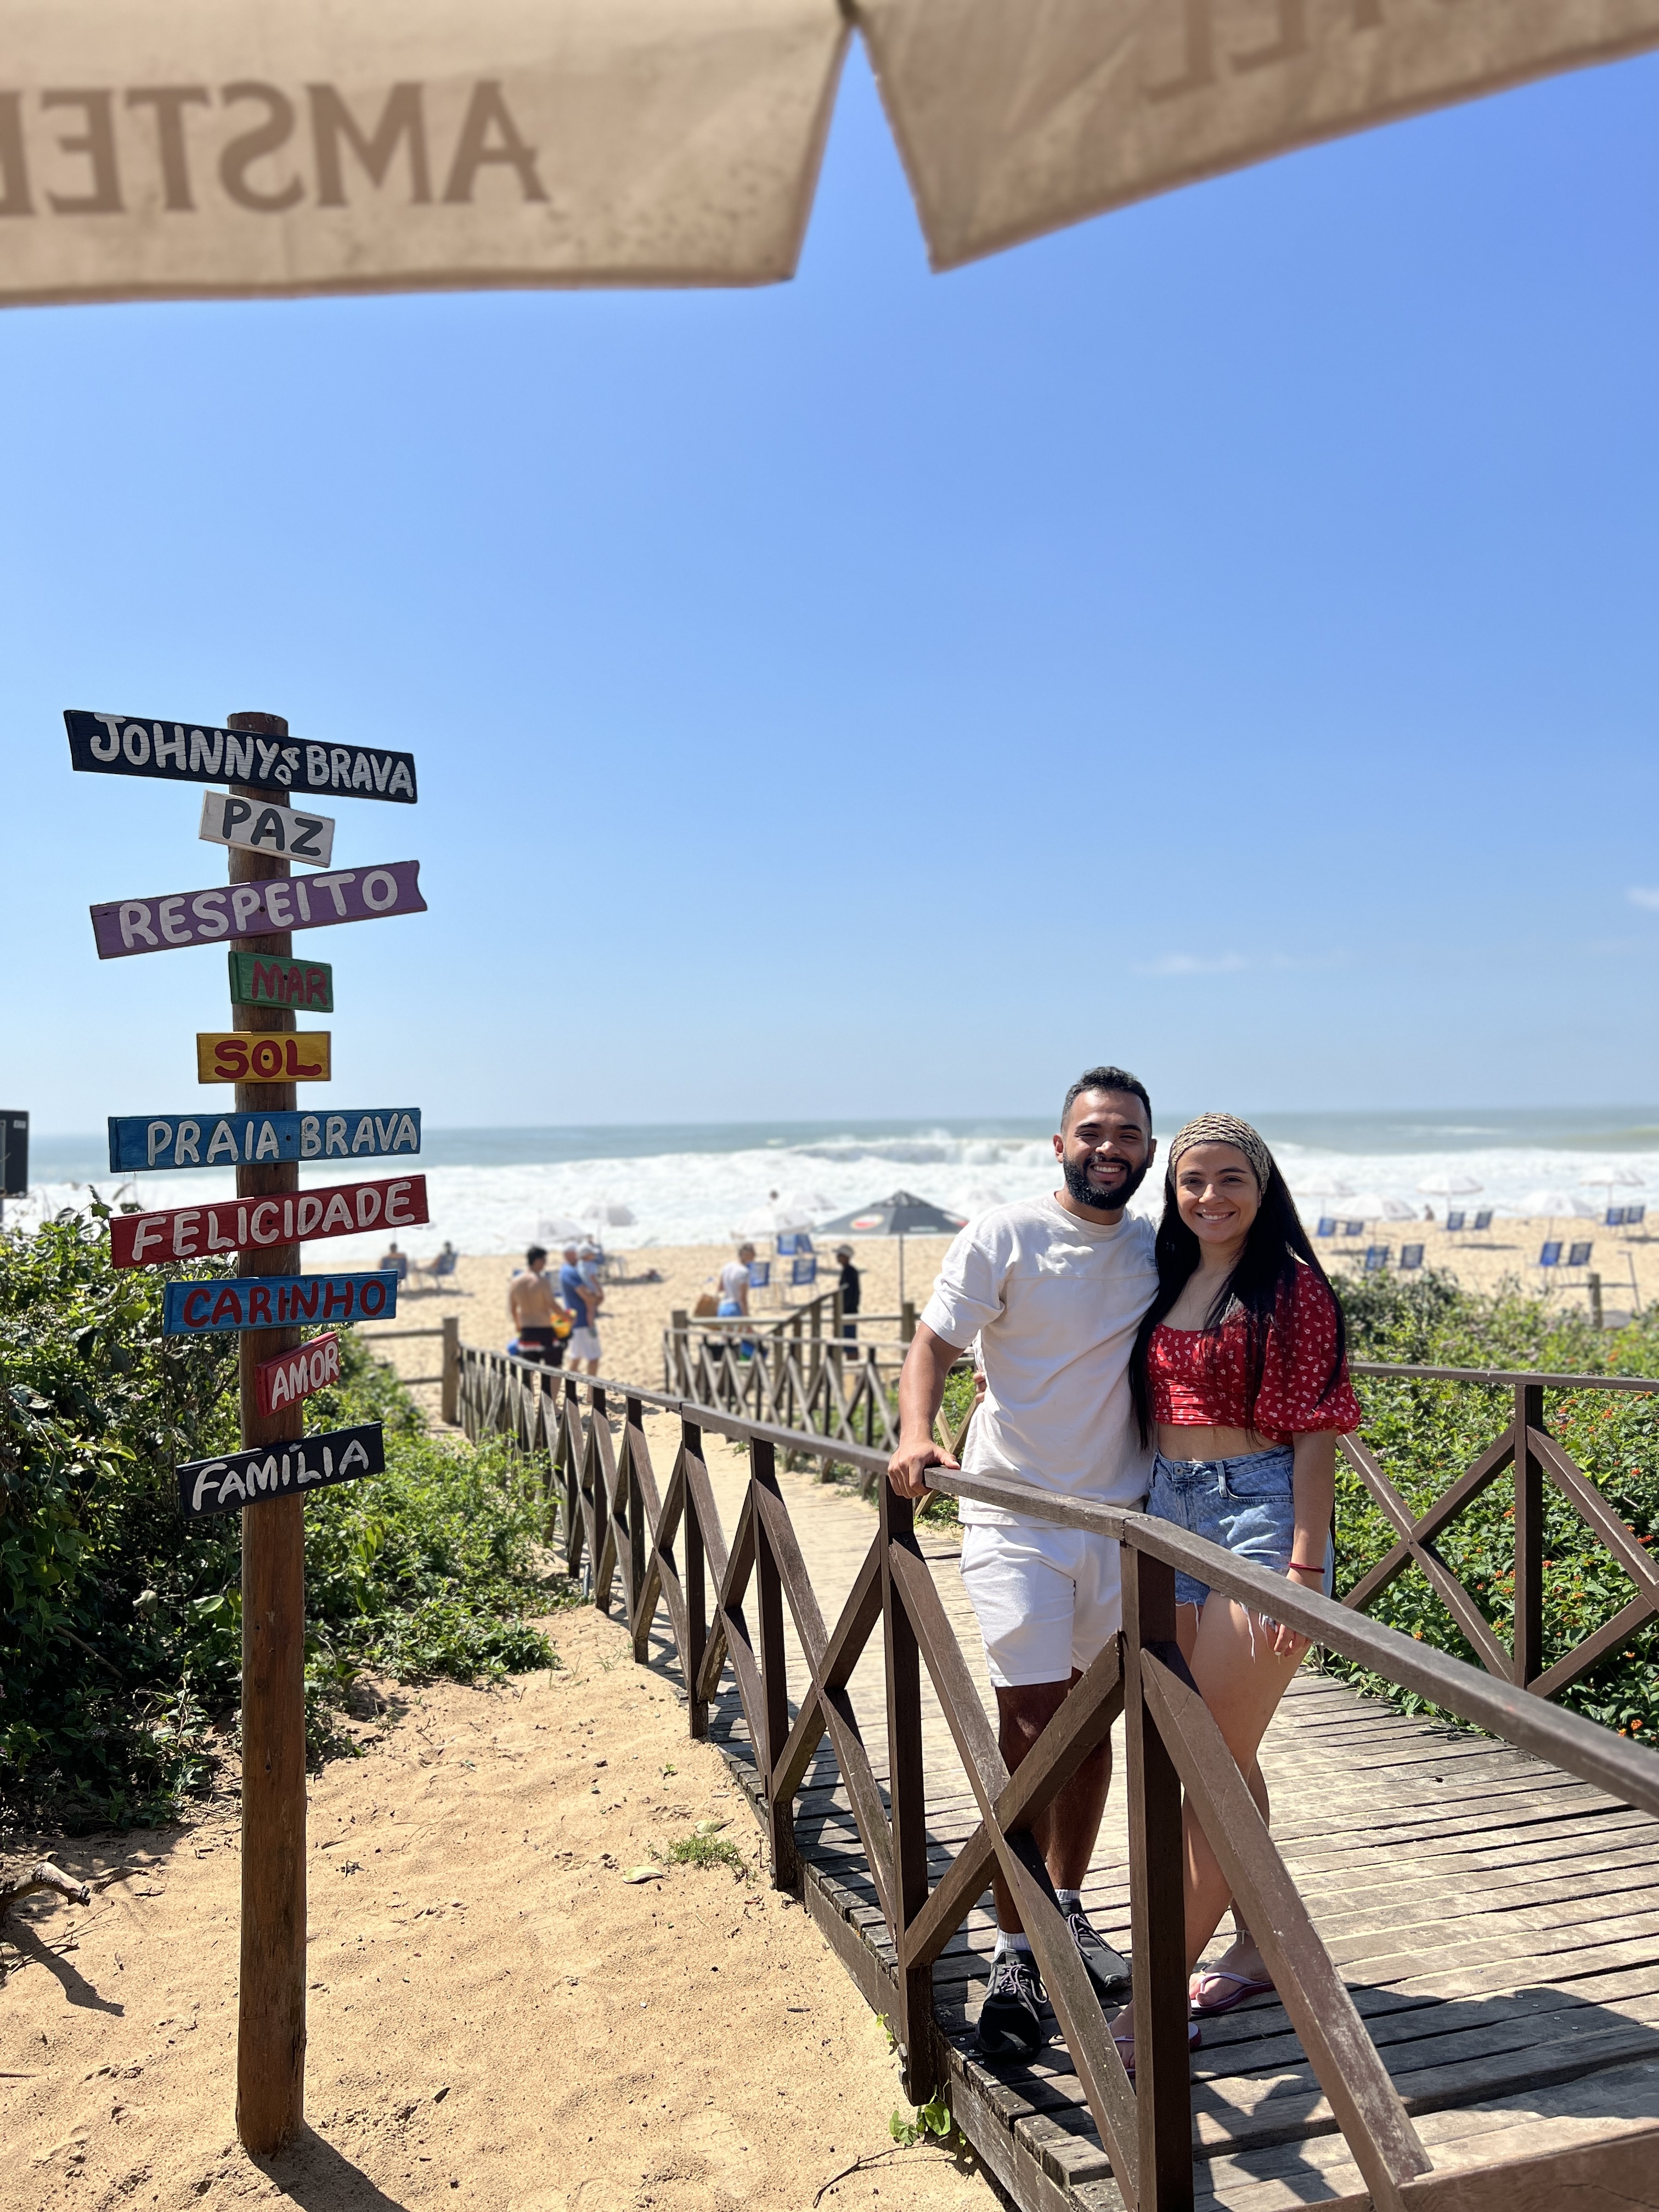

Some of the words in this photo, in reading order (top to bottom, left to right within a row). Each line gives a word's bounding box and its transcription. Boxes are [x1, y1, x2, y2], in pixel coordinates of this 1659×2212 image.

[90, 713, 279, 780] JOHNNY
[306, 744, 415, 798] BRAVA
[222, 798, 324, 857] PAZ
[119, 870, 398, 950] RESPEITO
[251, 960, 329, 1006] MAR
[214, 1039, 323, 1079] SOL
[147, 1120, 280, 1166] PRAIA
[300, 1113, 417, 1158] BRAVA
[131, 1181, 416, 1262] FELICIDADE
[182, 1279, 387, 1328] CARINHO
[271, 1340, 340, 1410] AMOR
[191, 1438, 370, 1511] FAMÍLIA
